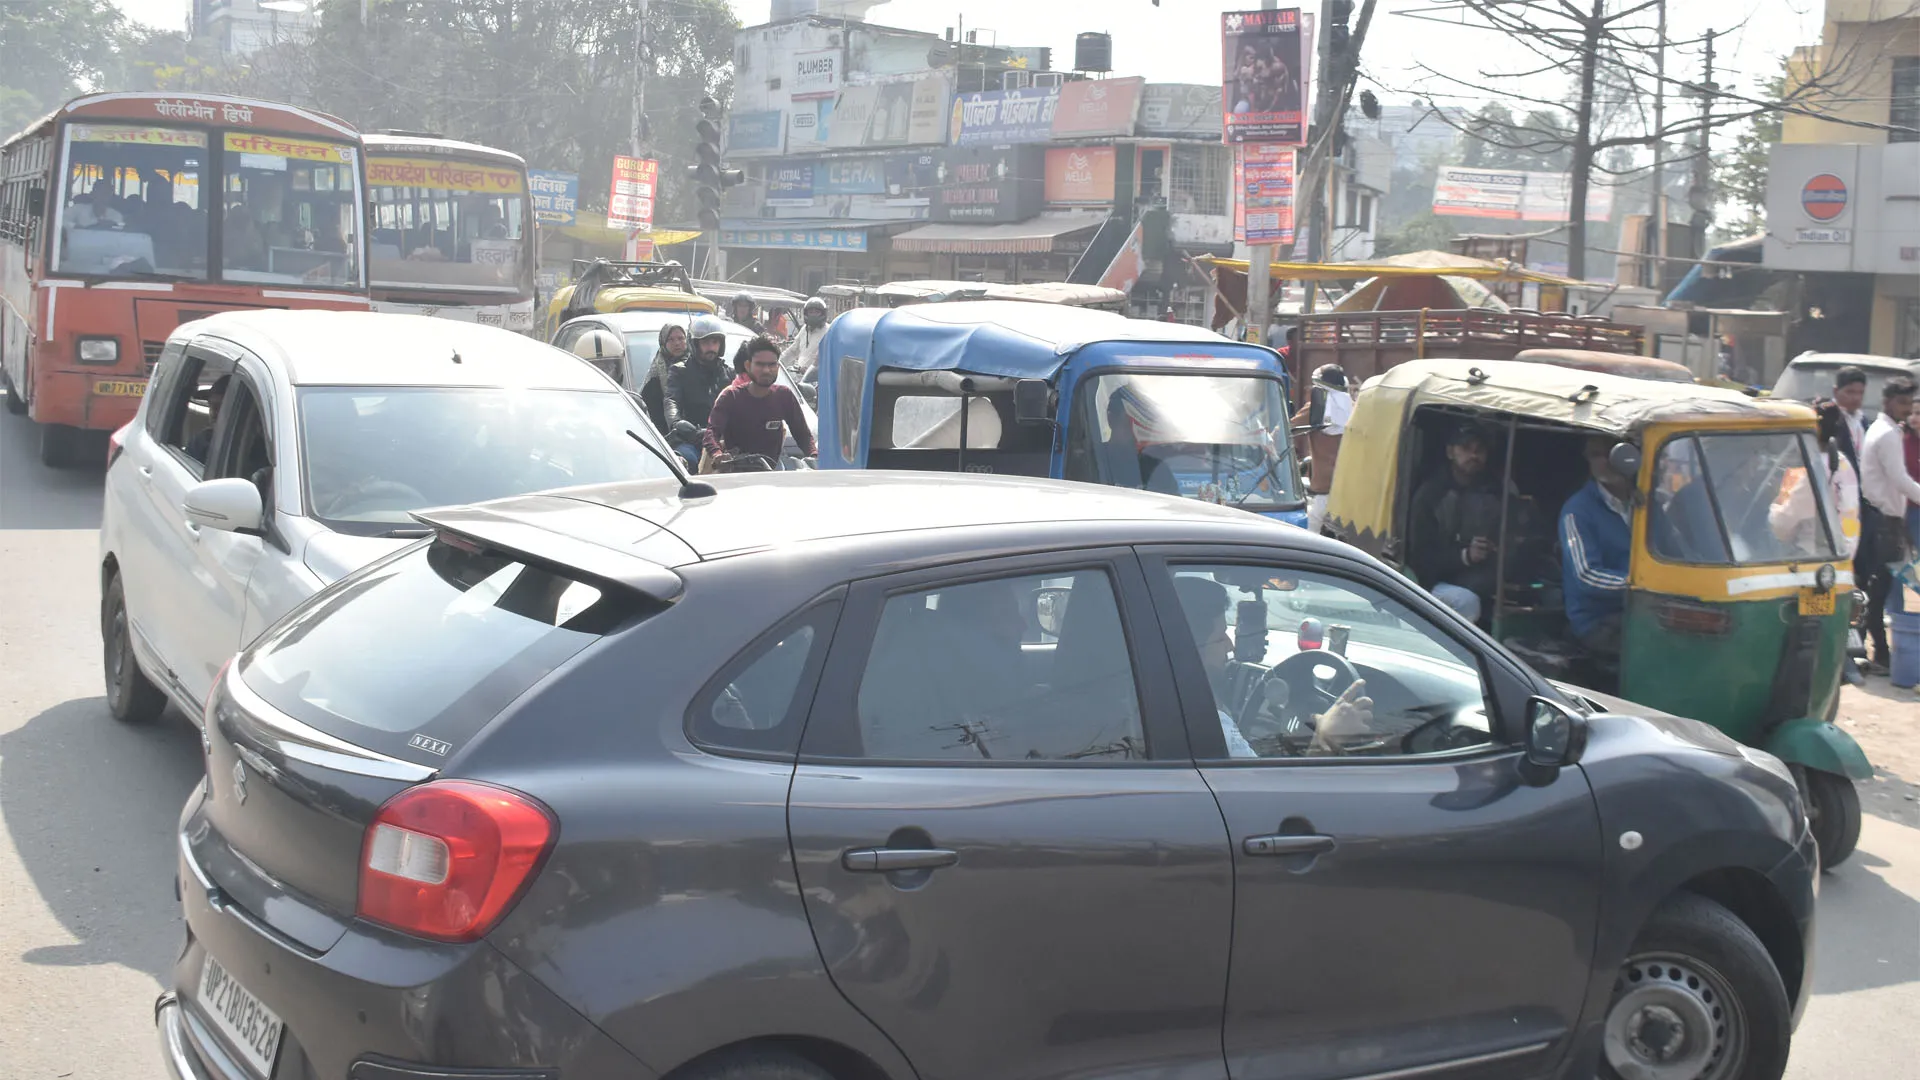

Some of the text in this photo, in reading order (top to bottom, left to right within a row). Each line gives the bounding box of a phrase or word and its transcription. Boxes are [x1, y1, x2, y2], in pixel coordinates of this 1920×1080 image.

[798, 58, 834, 76] PLUMBER
[154, 99, 253, 123] पीलीभीत डिपो
[230, 136, 332, 160] परिवहन
[617, 158, 656, 173] GURU JI
[778, 168, 800, 181] ASTRAL
[829, 161, 875, 184] CERA
[1064, 171, 1093, 184] WELLA
[1798, 230, 1846, 242] Indian Oil
[411, 735, 447, 754] NEXA
[205, 959, 278, 1063] UP21BU3628
